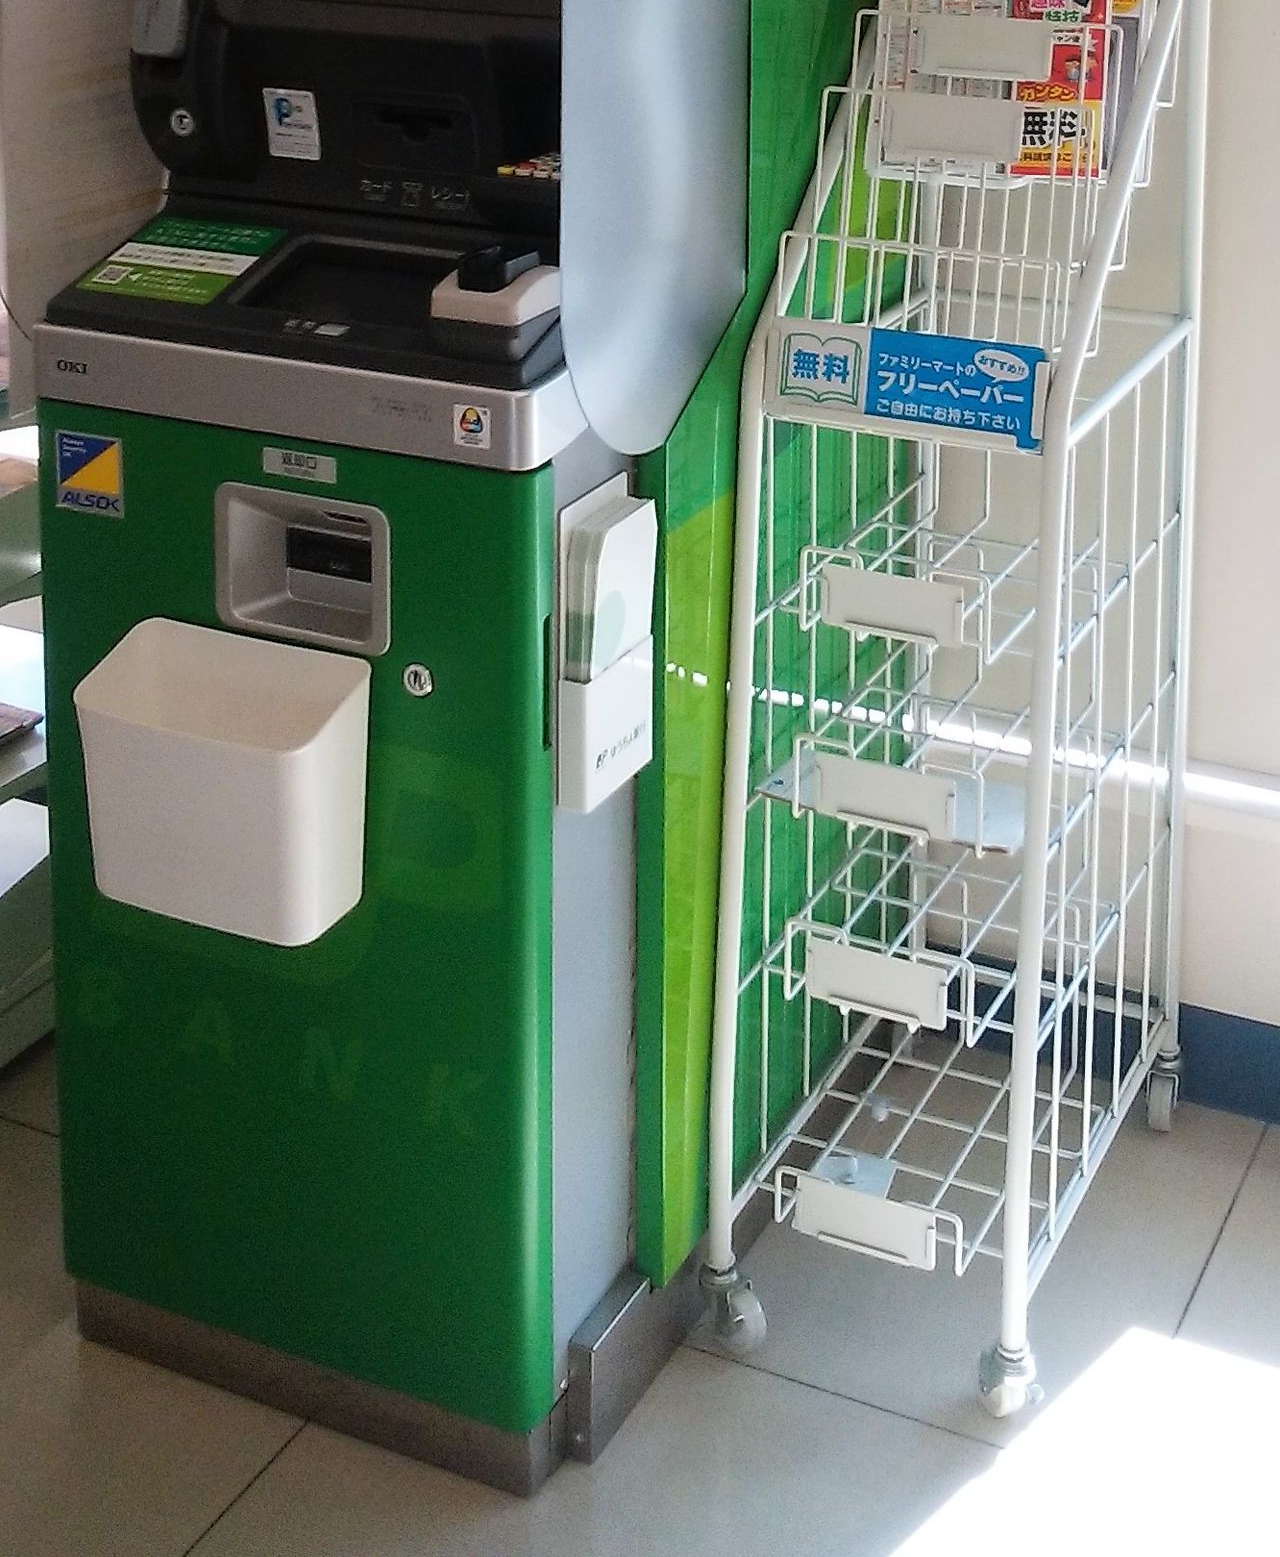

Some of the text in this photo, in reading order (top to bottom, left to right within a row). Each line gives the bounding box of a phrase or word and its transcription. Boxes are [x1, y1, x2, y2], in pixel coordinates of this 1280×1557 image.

[56, 359, 88, 375] OKI
[791, 347, 851, 385] 無料
[877, 352, 977, 378] ファミリーマートの
[977, 353, 1027, 377] おすすめ!!
[876, 369, 1026, 405] フリーペーパー
[876, 396, 1022, 431] ご自由にお持ち下さい
[62, 490, 120, 512] ALSOK
